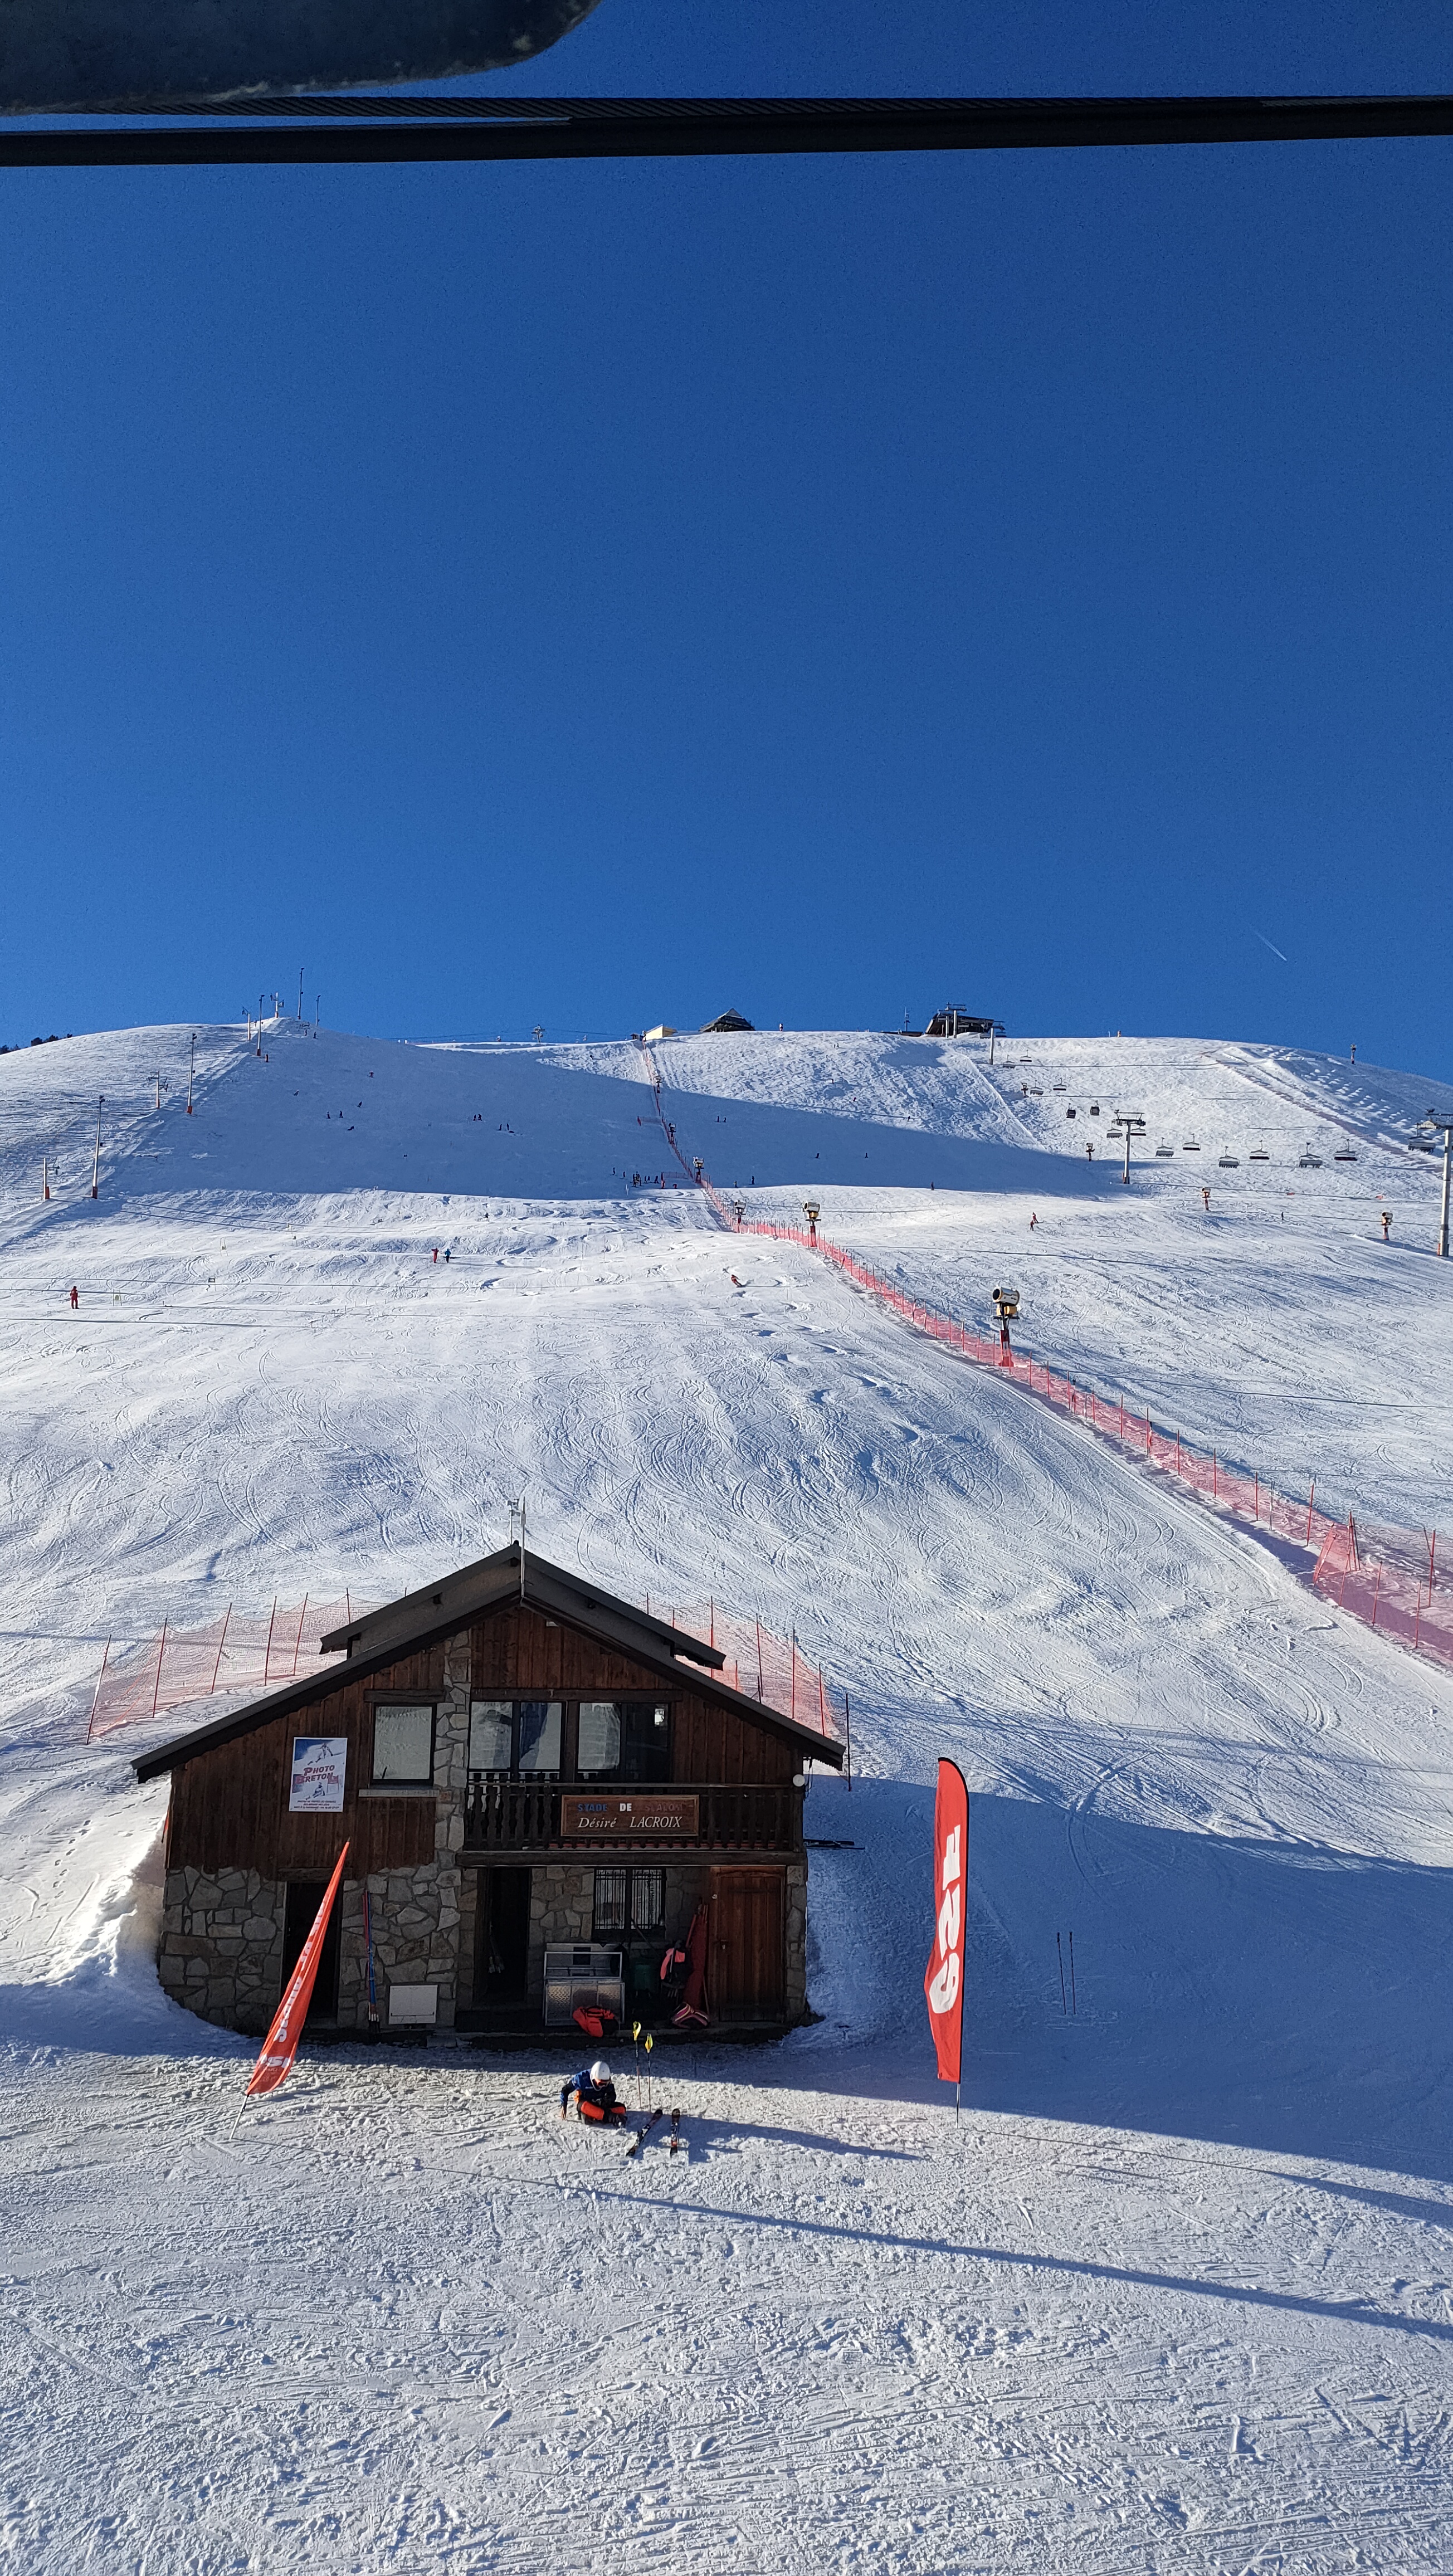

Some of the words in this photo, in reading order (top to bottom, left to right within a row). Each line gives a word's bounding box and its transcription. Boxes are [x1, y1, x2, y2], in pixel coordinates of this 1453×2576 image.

[577, 1803, 607, 1812] STADE
[620, 1803, 632, 1812] DE
[578, 1817, 617, 1828] Désiré
[630, 1816, 682, 1828] LACROIX
